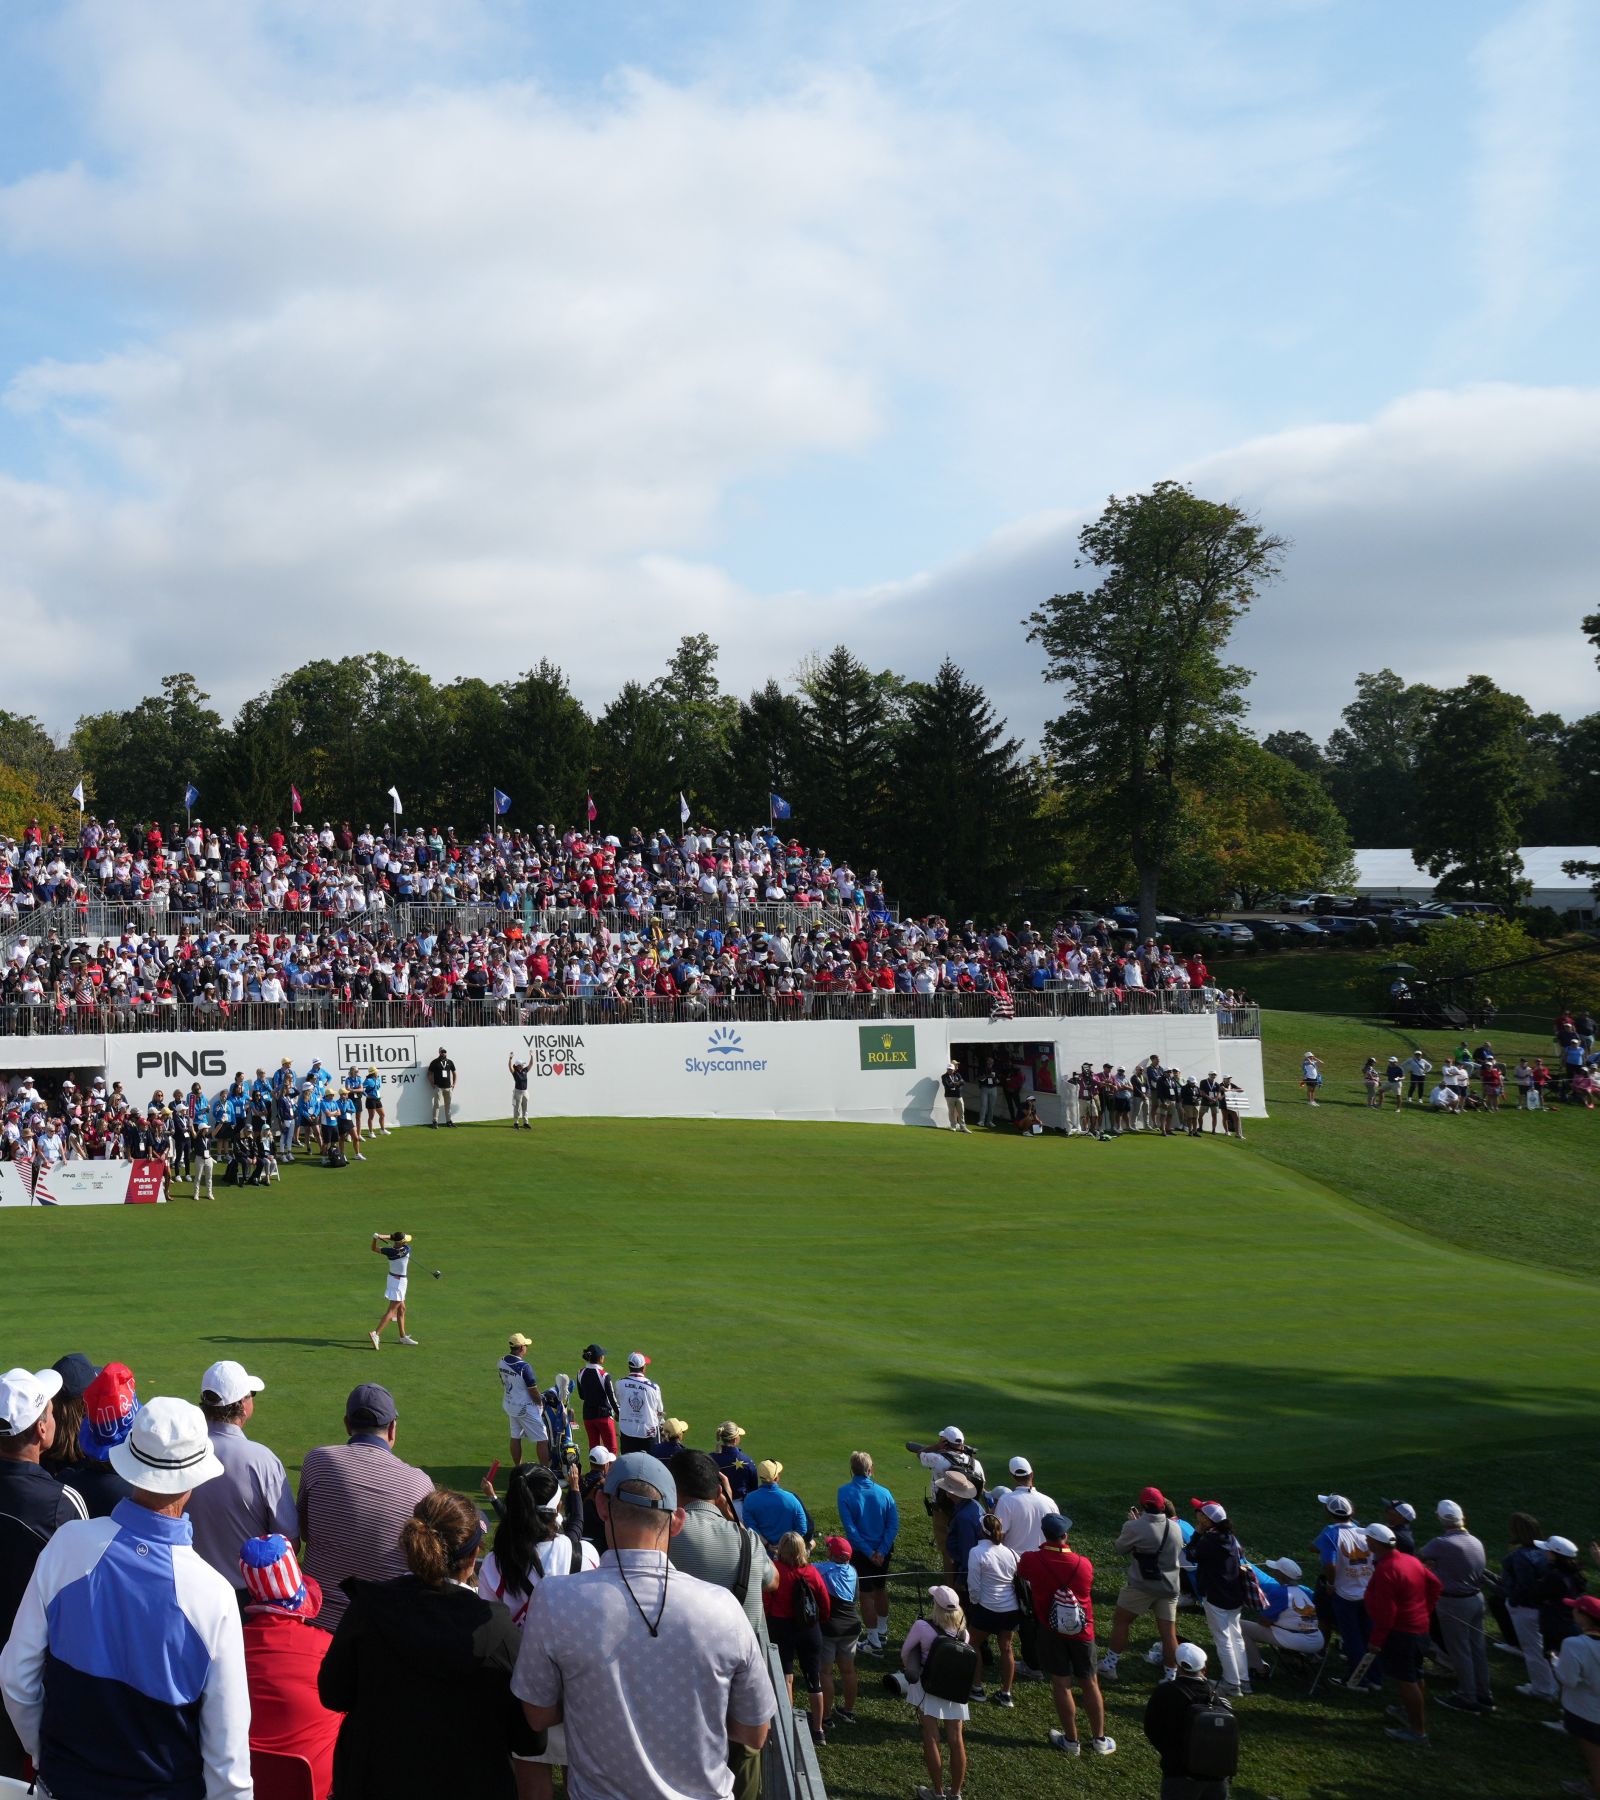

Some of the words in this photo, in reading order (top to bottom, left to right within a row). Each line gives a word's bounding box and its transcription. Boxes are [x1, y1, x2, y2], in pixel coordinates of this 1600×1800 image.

[523, 1035, 584, 1048] VIRGINIA
[344, 1043, 410, 1063] Hilton
[536, 1049, 546, 1062] IS
[549, 1049, 576, 1062] FOR
[867, 1051, 909, 1063] ROLEX
[136, 1049, 227, 1079] PING
[685, 1057, 768, 1076] Skyscanner
[391, 1074, 417, 1084] STAY
[142, 1165, 150, 1176] 1
